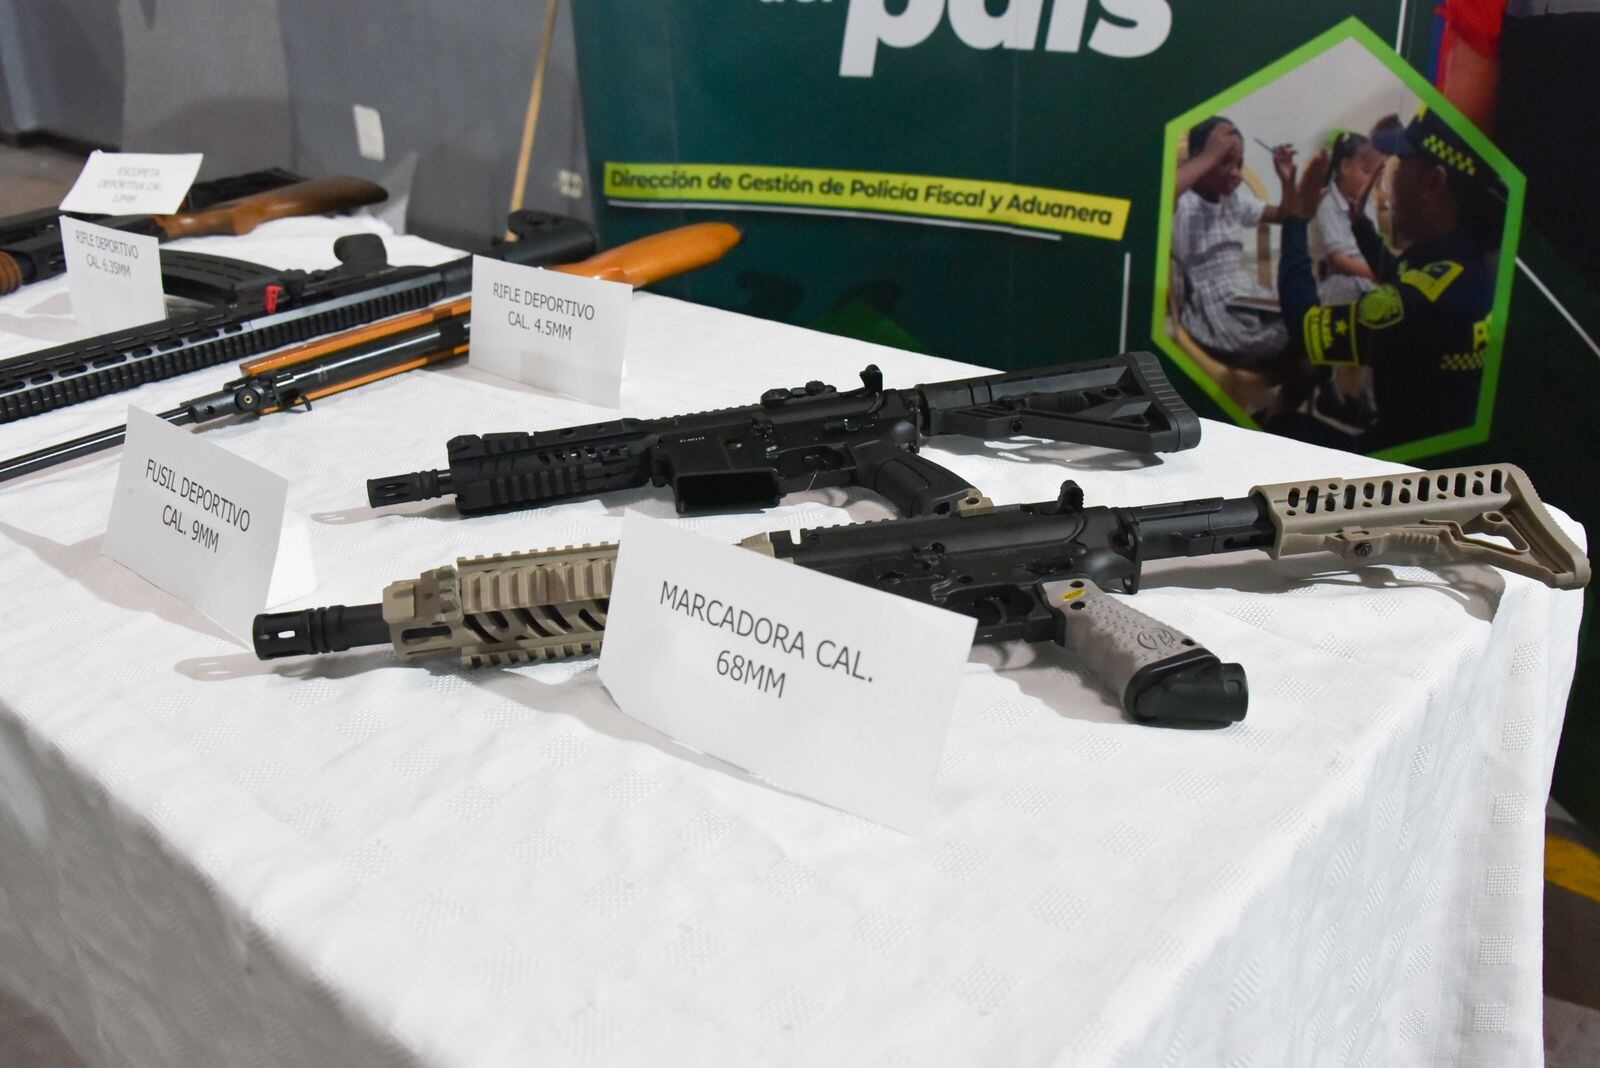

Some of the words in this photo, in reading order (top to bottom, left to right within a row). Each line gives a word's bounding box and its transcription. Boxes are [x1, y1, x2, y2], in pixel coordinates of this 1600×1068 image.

[611, 169, 702, 189] Dirección
[707, 172, 732, 190] de
[738, 173, 814, 194] Gestión
[819, 178, 845, 196] de
[851, 179, 919, 201] Policía
[924, 184, 986, 207] Fiscal
[988, 195, 1002, 213] y
[1006, 193, 1113, 225] Aduanera
[75, 230, 95, 247] RIFLE
[95, 235, 139, 259] DEPORTIVO
[103, 258, 131, 278] 6.35MM
[493, 282, 521, 303] RIFLE
[524, 290, 595, 321] DEPORTIVO
[508, 310, 531, 330] CAL.
[534, 318, 572, 341] 4.5MM
[145, 458, 177, 493] FUSIL
[180, 477, 250, 532] DEPORTIVO
[162, 504, 187, 535] CAL.
[191, 520, 219, 553] 9MM
[660, 580, 805, 659] MARCADORA
[816, 639, 873, 682] CAL.
[716, 649, 786, 698] 68MM
